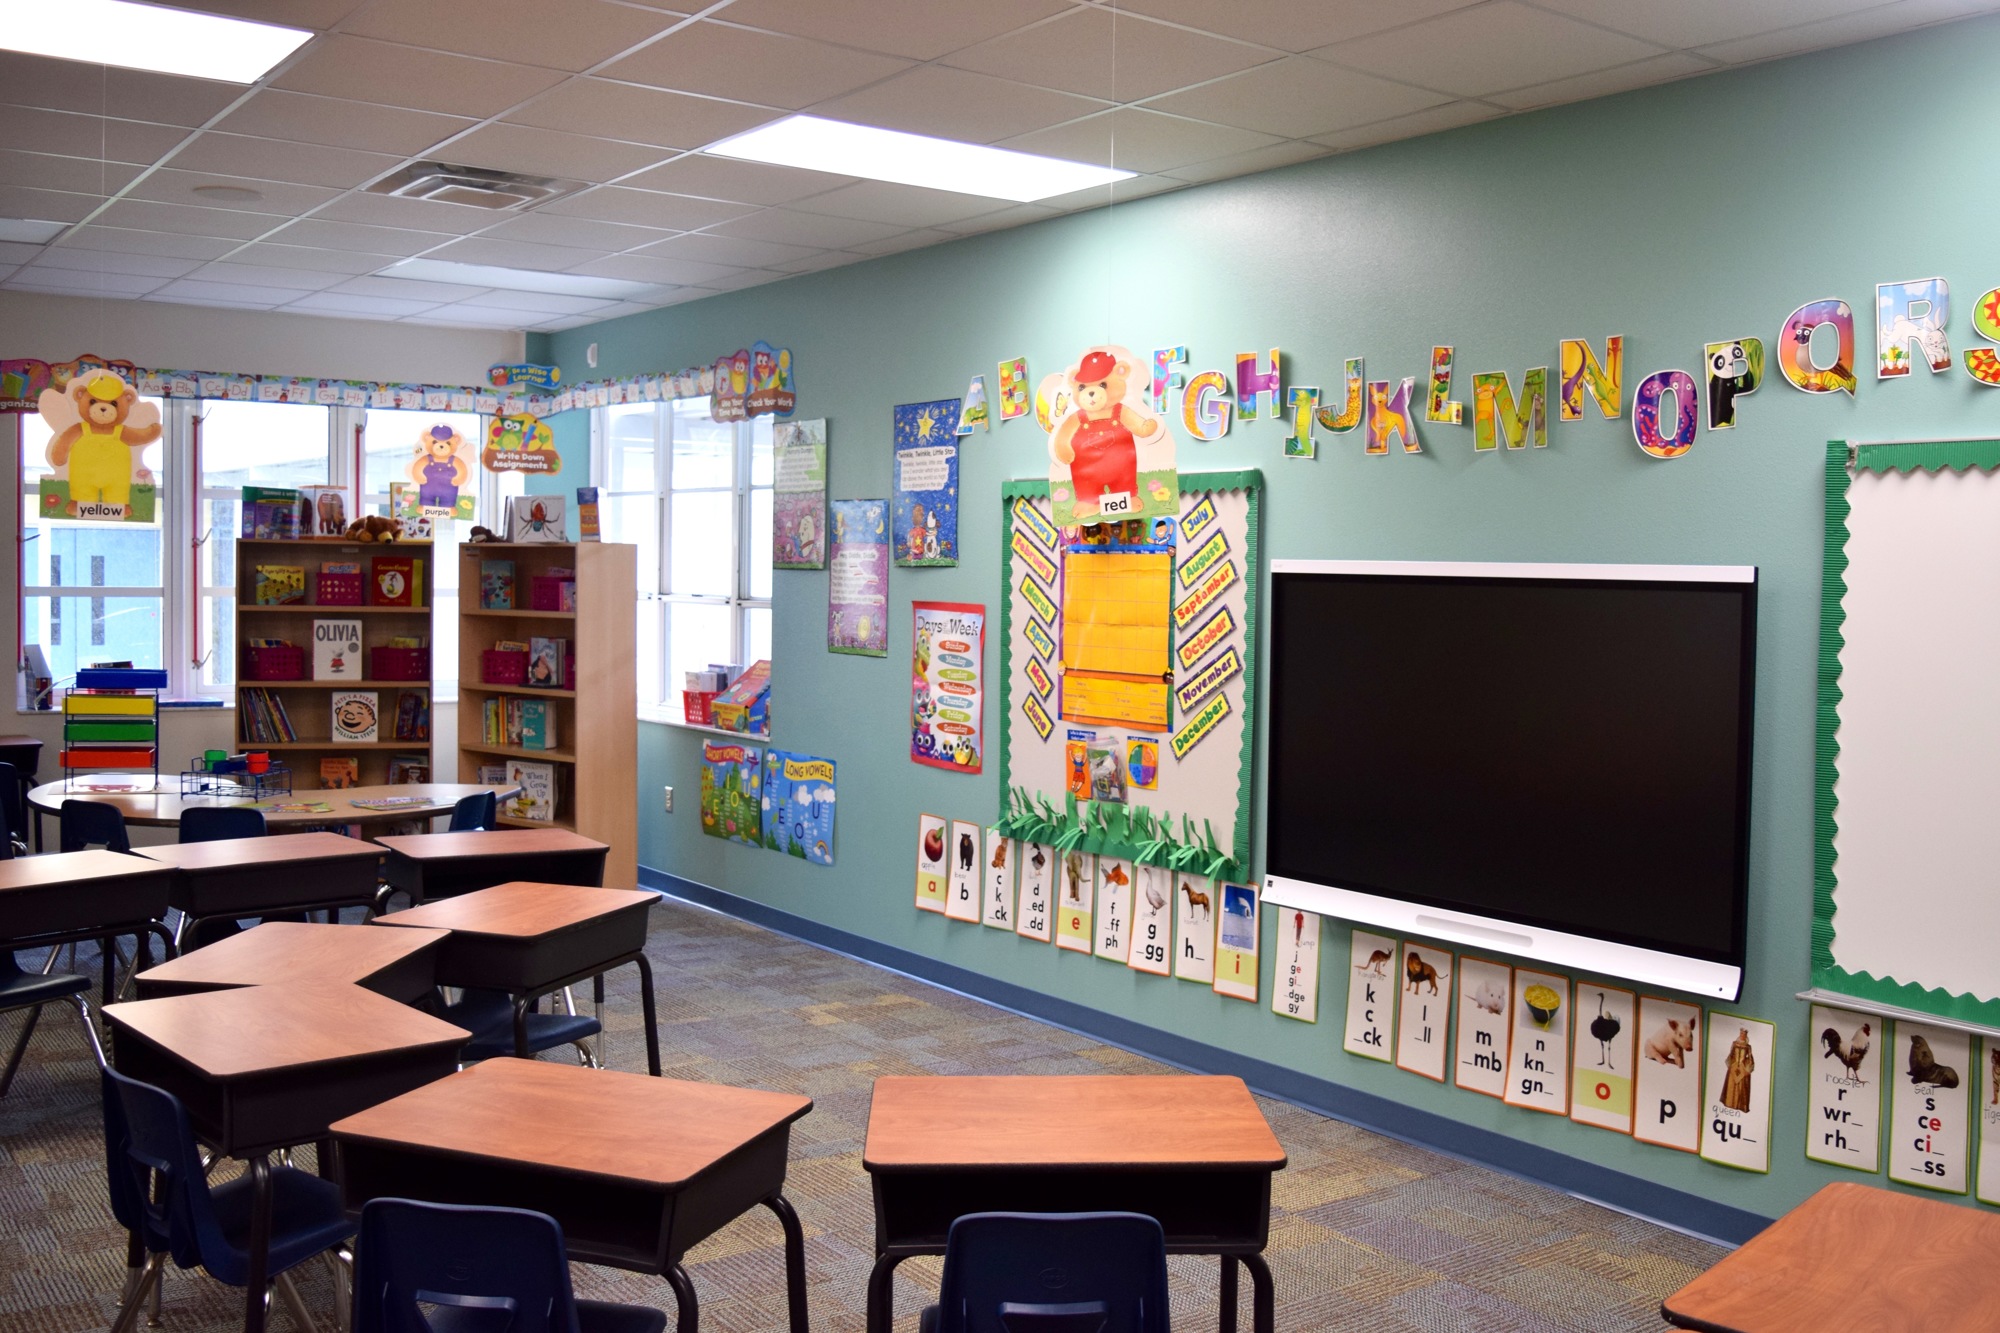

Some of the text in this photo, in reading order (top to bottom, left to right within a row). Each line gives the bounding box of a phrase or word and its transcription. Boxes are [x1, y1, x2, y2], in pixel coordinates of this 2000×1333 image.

[527, 367, 547, 376] Wise
[956, 375, 989, 436] A
[998, 356, 1028, 421] B
[1152, 344, 1187, 414] F
[1181, 369, 1230, 440] G
[1236, 347, 1281, 421] H
[1284, 386, 1319, 458] I
[1315, 357, 1363, 434] J
[1366, 376, 1423, 454] K
[1426, 345, 1463, 424] L
[1471, 366, 1548, 451] M
[1559, 334, 1624, 421] N
[1631, 369, 1700, 459] O
[1704, 336, 1765, 431] P
[1777, 298, 1857, 399] Q
[1876, 276, 1952, 380] R
[513, 375, 547, 383] Learner
[143, 381, 159, 393] Aa
[175, 381, 191, 393] Bb
[206, 381, 221, 392] Cc
[231, 383, 248, 396] Dd
[264, 386, 278, 397] Ee
[291, 387, 304, 399] Ff
[318, 390, 336, 404] Gg
[747, 397, 793, 408] Check Your Work
[496, 452, 545, 461] Write Down
[493, 460, 548, 470] Assignments
[79, 504, 123, 519] yellow
[1104, 496, 1128, 512] red
[424, 508, 450, 520] purple
[1187, 506, 1209, 532] July
[1018, 502, 1052, 543] January
[1014, 536, 1052, 580] February
[1185, 540, 1221, 580] August
[1025, 583, 1050, 618] March
[315, 624, 359, 642] OLIVIA
[917, 616, 943, 637] Days
[949, 619, 978, 636] Week
[1028, 624, 1050, 653] April
[1183, 615, 1227, 660] October
[945, 641, 965, 653] Sunday
[945, 655, 967, 667] Monday
[1030, 663, 1047, 692] May
[1182, 655, 1232, 704] November
[335, 695, 352, 706] PETE'S
[359, 695, 376, 708] PIZZA
[1027, 700, 1047, 733] June
[334, 726, 359, 740] WILLIAM
[1174, 698, 1223, 752] December
[706, 747, 744, 763] SHORT VOWELS
[526, 772, 543, 781] When
[786, 762, 833, 780] LONG VOWELS
[529, 781, 548, 790] Grow
[765, 772, 773, 787] A
[537, 790, 547, 800] Up
[743, 779, 751, 798] U
[730, 791, 740, 807] O
[713, 799, 720, 816] E
[812, 801, 820, 820] U
[778, 807, 785, 825] E
[794, 822, 805, 840] O
[928, 880, 936, 893] a
[996, 874, 1002, 885] c
[960, 883, 969, 901] b
[995, 887, 1002, 903] k
[1033, 884, 1040, 896] d
[1110, 902, 1115, 914] f
[1071, 917, 1080, 930] e
[1148, 924, 1156, 940] g
[1105, 935, 1118, 950] ph
[1235, 954, 1240, 975] i
[1293, 951, 1298, 963] j
[1290, 965, 1301, 975] ge
[1365, 983, 1376, 1003] k
[1288, 1003, 1300, 1015] gy
[1365, 1009, 1374, 1022] c
[1476, 1030, 1492, 1047] m
[1535, 1039, 1545, 1052] n
[1825, 1072, 1870, 1089] rooster
[1595, 1082, 1611, 1101] o
[1838, 1087, 1847, 1101] r
[1914, 1085, 1935, 1097] seal
[1659, 1098, 1677, 1124] p
[1712, 1105, 1741, 1118] queen
[1925, 1097, 1936, 1112] s
[1918, 1116, 1942, 1132] ce
